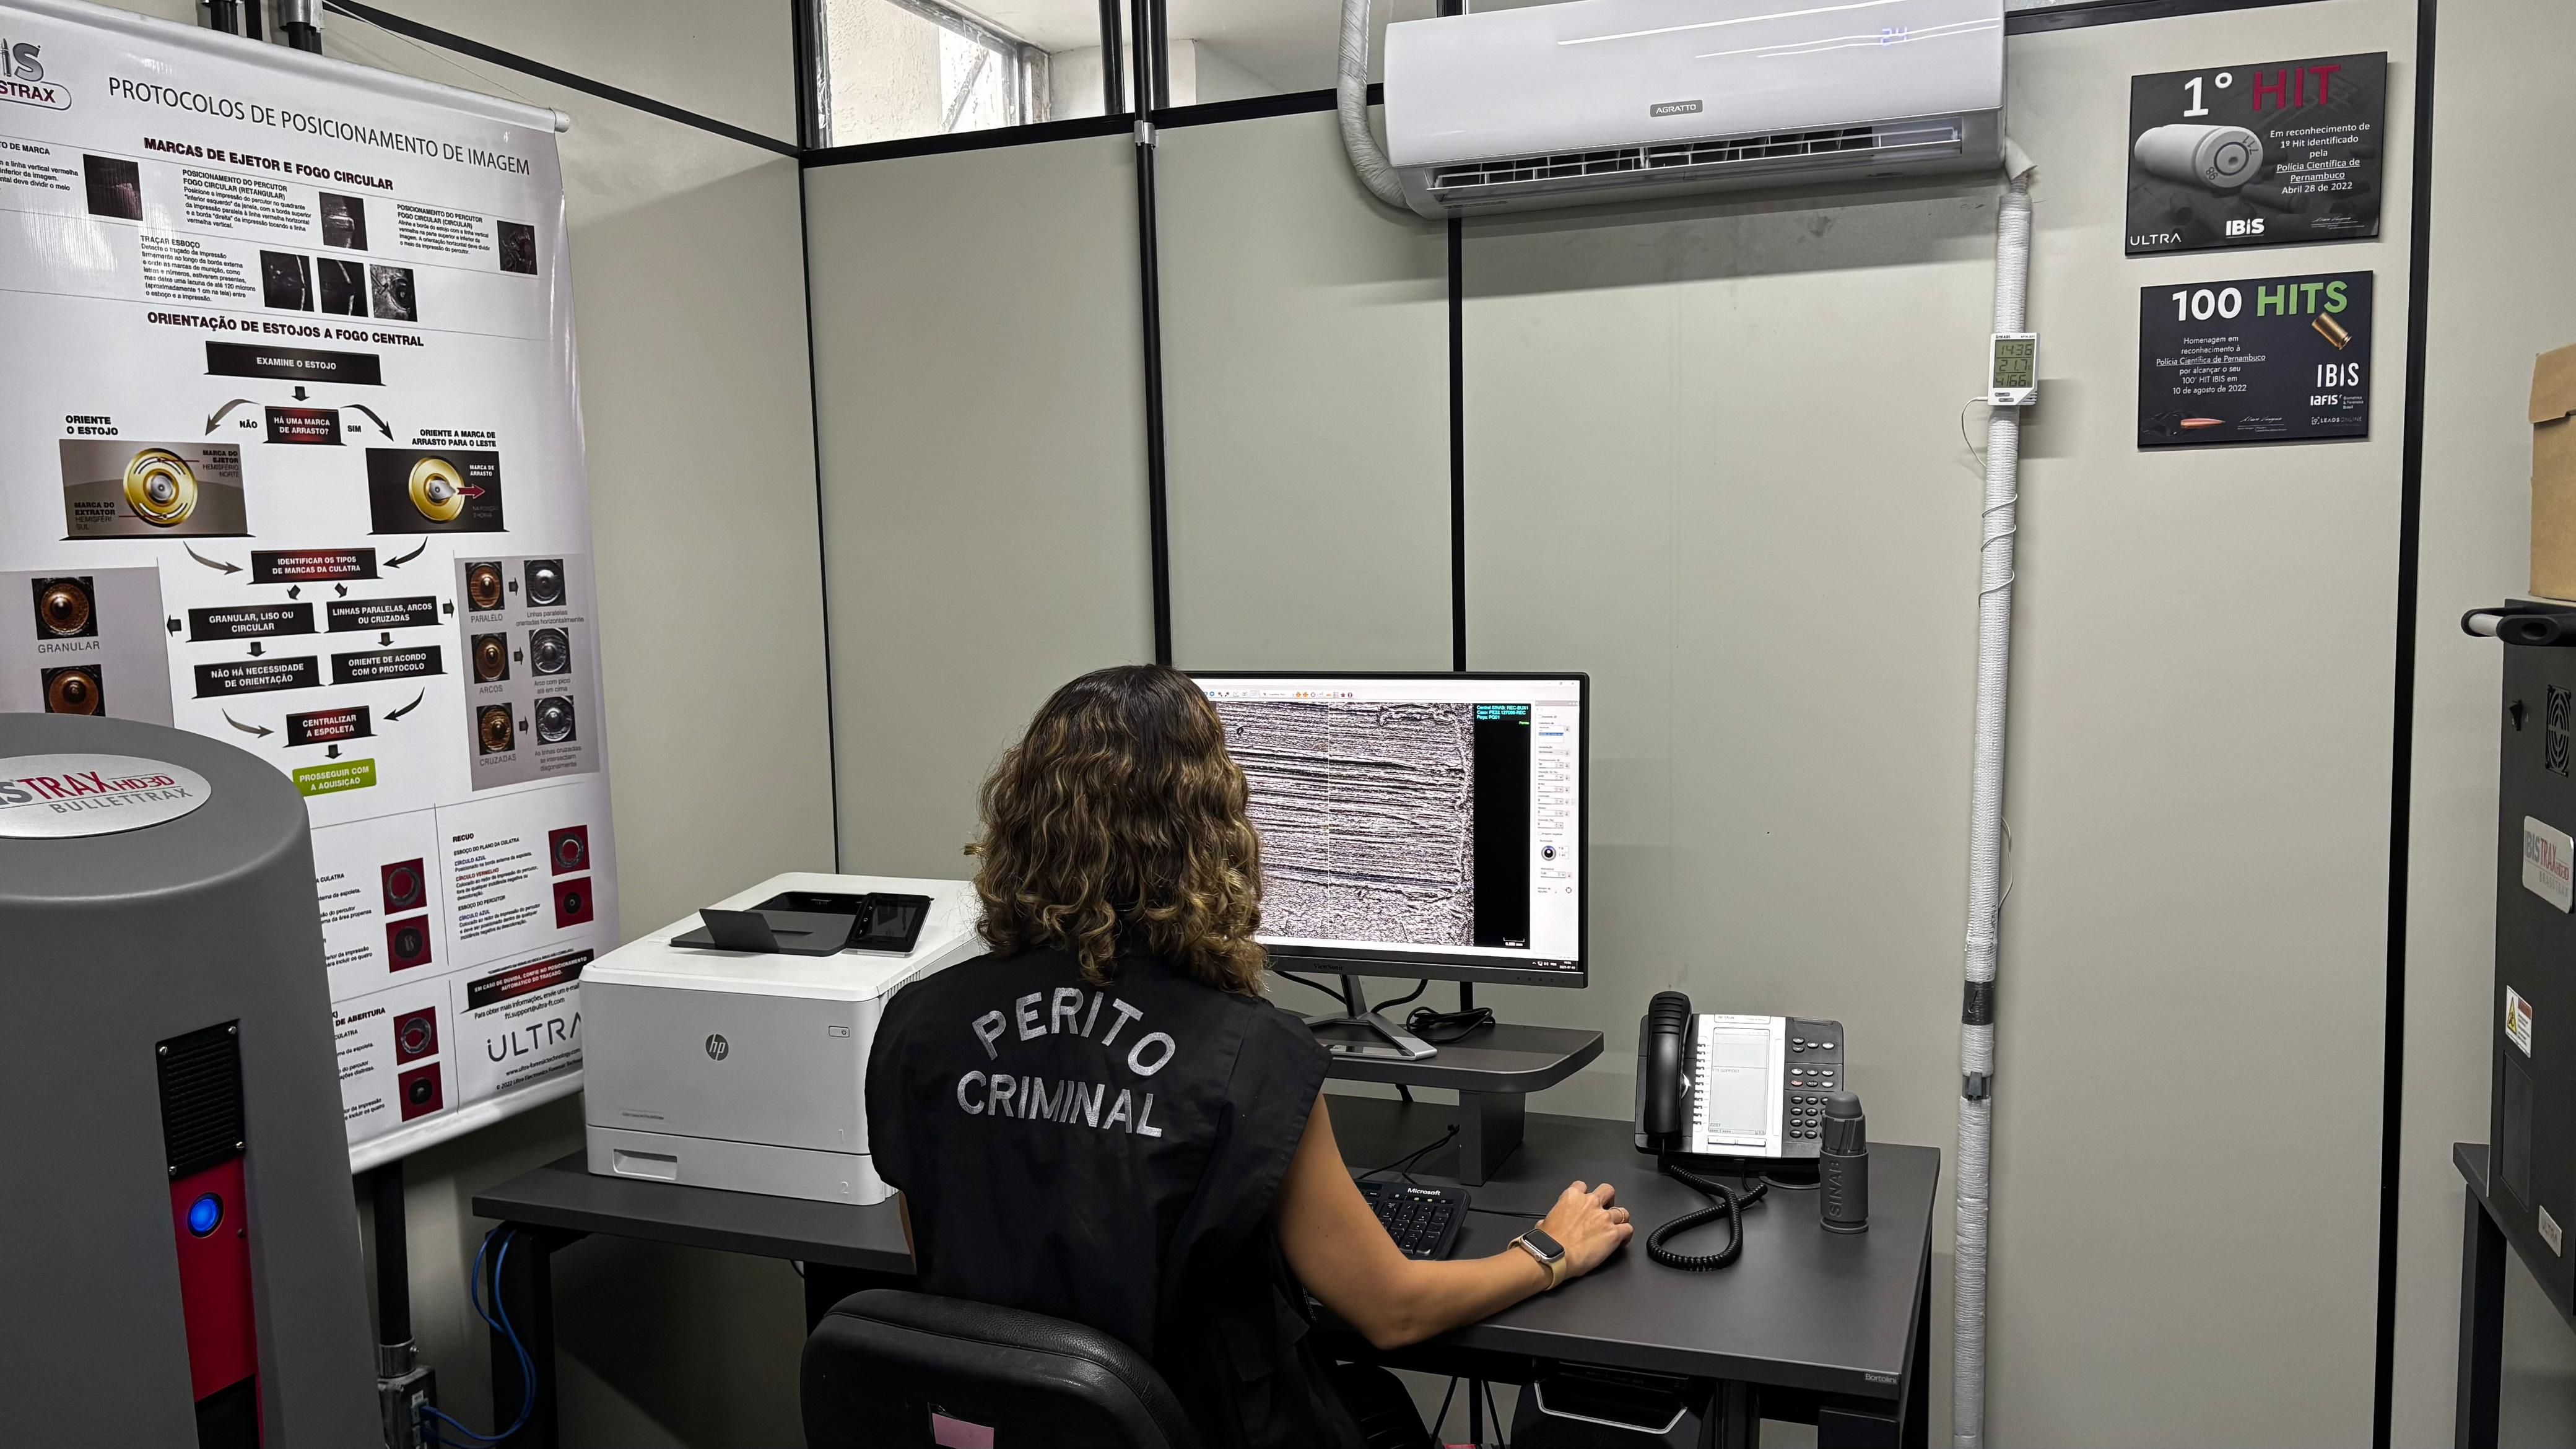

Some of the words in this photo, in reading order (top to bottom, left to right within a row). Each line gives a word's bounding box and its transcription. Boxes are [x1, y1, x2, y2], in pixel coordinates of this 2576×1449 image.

[2253, 64, 2341, 111] HIT
[1656, 104, 1696, 114] AGRATTO
[109, 77, 245, 121] PROTOCOLOS
[251, 105, 276, 126] DE
[281, 111, 438, 157] POSICIONAMENTO
[443, 142, 463, 163] DE
[468, 148, 530, 176] IMAGEM
[2286, 126, 2356, 136] reconhecimento
[2292, 139, 2305, 147] Hit
[2307, 135, 2359, 146] identificado
[2310, 149, 2328, 159] pela
[144, 137, 202, 158] MARCAS
[207, 148, 225, 162] DE
[230, 152, 280, 172] EJETOR
[284, 162, 292, 173] E
[297, 165, 330, 179] FOGO
[334, 171, 393, 190] CIRCULAR
[2277, 163, 2304, 171] Polícia
[2307, 160, 2346, 169] Científica
[2349, 158, 2360, 166] de
[183, 169, 241, 185] POSICIONAMENTO
[254, 181, 287, 192] PERCUTOR
[2291, 172, 2345, 181] Pernambuco
[183, 178, 202, 186] FOGO
[204, 181, 237, 192] CIRCULAR
[239, 187, 285, 201] (RETANGULAR)
[2282, 185, 2302, 194] Abril
[2305, 185, 2315, 193] 28
[2331, 182, 2352, 191] 2022
[141, 235, 169, 246] TRAÇAR
[172, 238, 200, 249] ESBOÇO
[2130, 233, 2182, 246] ULTRA
[2172, 287, 2242, 321] 100
[2257, 281, 2348, 316] HITS
[147, 311, 237, 332] ORIENTAÇÃO
[242, 320, 259, 332] DE
[263, 323, 320, 337] ESTOJOS
[324, 328, 333, 339] A
[336, 329, 368, 342] FOGO
[372, 333, 424, 346] CENTRAL
[2183, 337, 2226, 345] Homenagem
[2182, 345, 2234, 354] reconhecimento
[256, 357, 294, 368] EXAMINE
[297, 360, 303, 368] O
[305, 360, 336, 370] ESTOJO
[2180, 356, 2211, 365] Científica
[2224, 354, 2266, 362] Pernambuco
[2317, 362, 2359, 388] IBIS
[2193, 386, 2215, 395] agosto
[66, 415, 111, 425] ORIENTE
[239, 419, 258, 429] NÃO
[274, 416, 284, 425] HÁ
[286, 418, 303, 426] UMA
[304, 419, 331, 427] MARCA
[67, 426, 74, 435] O
[77, 426, 118, 436] ESTOJO
[291, 426, 329, 435] ARRASTO?
[347, 425, 362, 433] SIM
[420, 429, 451, 438] ORIENTE
[412, 438, 446, 446] ARRASTO
[469, 439, 475, 447] O
[476, 440, 497, 448] LESTE
[277, 557, 323, 566] IDENTIFICAR
[285, 565, 315, 574] MARCAS
[329, 565, 360, 573] CULATRA
[333, 606, 360, 616] LINHAS
[362, 604, 405, 615] PARALELAS,
[407, 603, 432, 611] ARCOS
[209, 614, 258, 624] GRANULAR,
[261, 612, 281, 621] LISO
[282, 611, 294, 619] OU
[359, 616, 369, 624] OU
[370, 614, 410, 624] CRUZADAS
[471, 614, 503, 624] PARALELO
[232, 622, 275, 633] CIRCULAR
[38, 641, 100, 654] GRANULAR
[348, 657, 381, 667] ORIENTE
[383, 656, 394, 664] DE
[395, 653, 427, 663] ACORDO
[211, 668, 230, 679] NÃO
[232, 666, 243, 677] HÁ
[245, 663, 304, 676] NECESSIDADE
[352, 668, 370, 676] COM
[372, 666, 378, 674] O
[379, 663, 425, 674] PROTOCOLO
[225, 679, 237, 688] DE
[239, 674, 294, 687] ORIENTAÇÃO
[479, 685, 503, 694] ARCOS
[302, 714, 357, 728] CENTRALIZAR
[307, 729, 312, 737] A
[314, 724, 355, 737] ESPOLETA
[480, 754, 516, 766] CRUZADAS
[300, 769, 349, 782] PROSSEGUIR
[352, 766, 369, 775] COM
[113, 775, 175, 791] HD3D
[48, 788, 193, 813] BULLETTRAX
[453, 833, 474, 842] RECUO
[474, 1011, 485, 1020] Para
[486, 1007, 499, 1016] obter
[500, 1003, 511, 1011] mais
[544, 990, 556, 998] envie
[336, 1018, 346, 1027] DE
[347, 1007, 386, 1024] ABERTURA
[972, 987, 1176, 1076] PERITO
[707, 1033, 729, 1061] hp
[957, 1070, 1162, 1138] CRIMINAL
[1407, 1188, 1441, 1196] Microsoft
[1865, 1373, 1896, 1383] Bortolini
